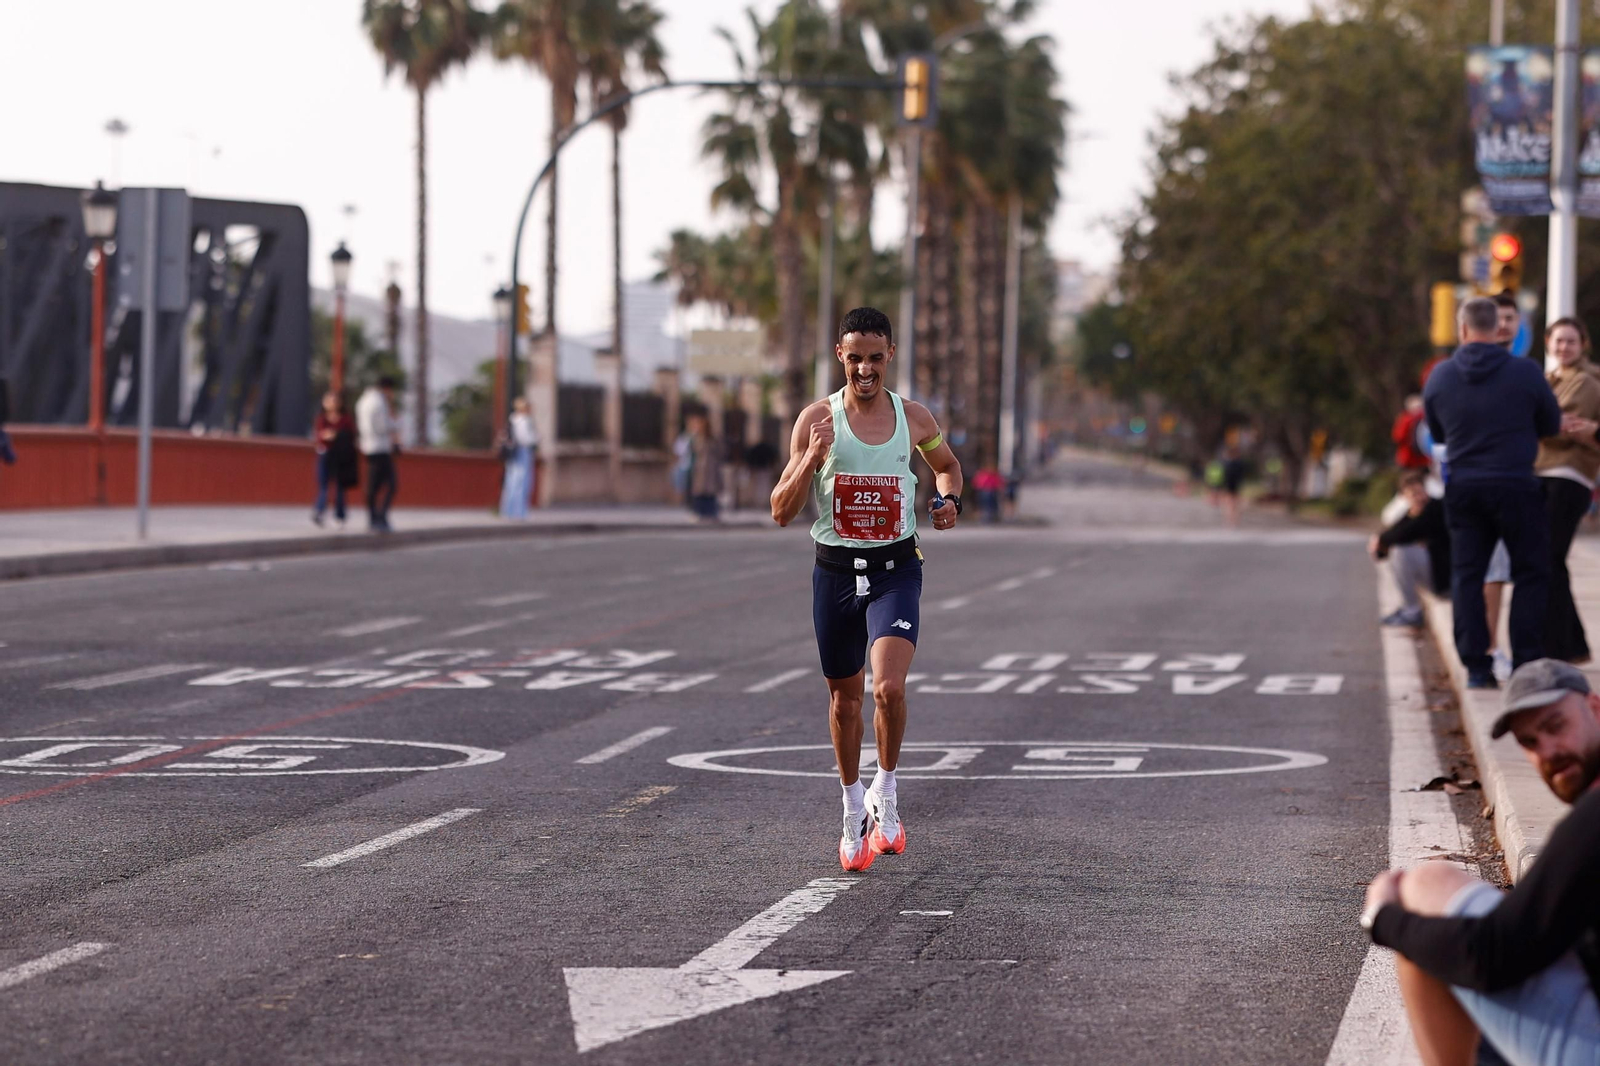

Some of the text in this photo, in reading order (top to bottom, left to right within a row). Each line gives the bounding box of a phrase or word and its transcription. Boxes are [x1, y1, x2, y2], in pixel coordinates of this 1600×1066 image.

[851, 477, 896, 486] GENERALI
[853, 491, 882, 505] 252
[980, 652, 1247, 672] RED
[186, 666, 719, 692] BASICA
[0, 743, 353, 769] 50
[831, 748, 1150, 772] 50
